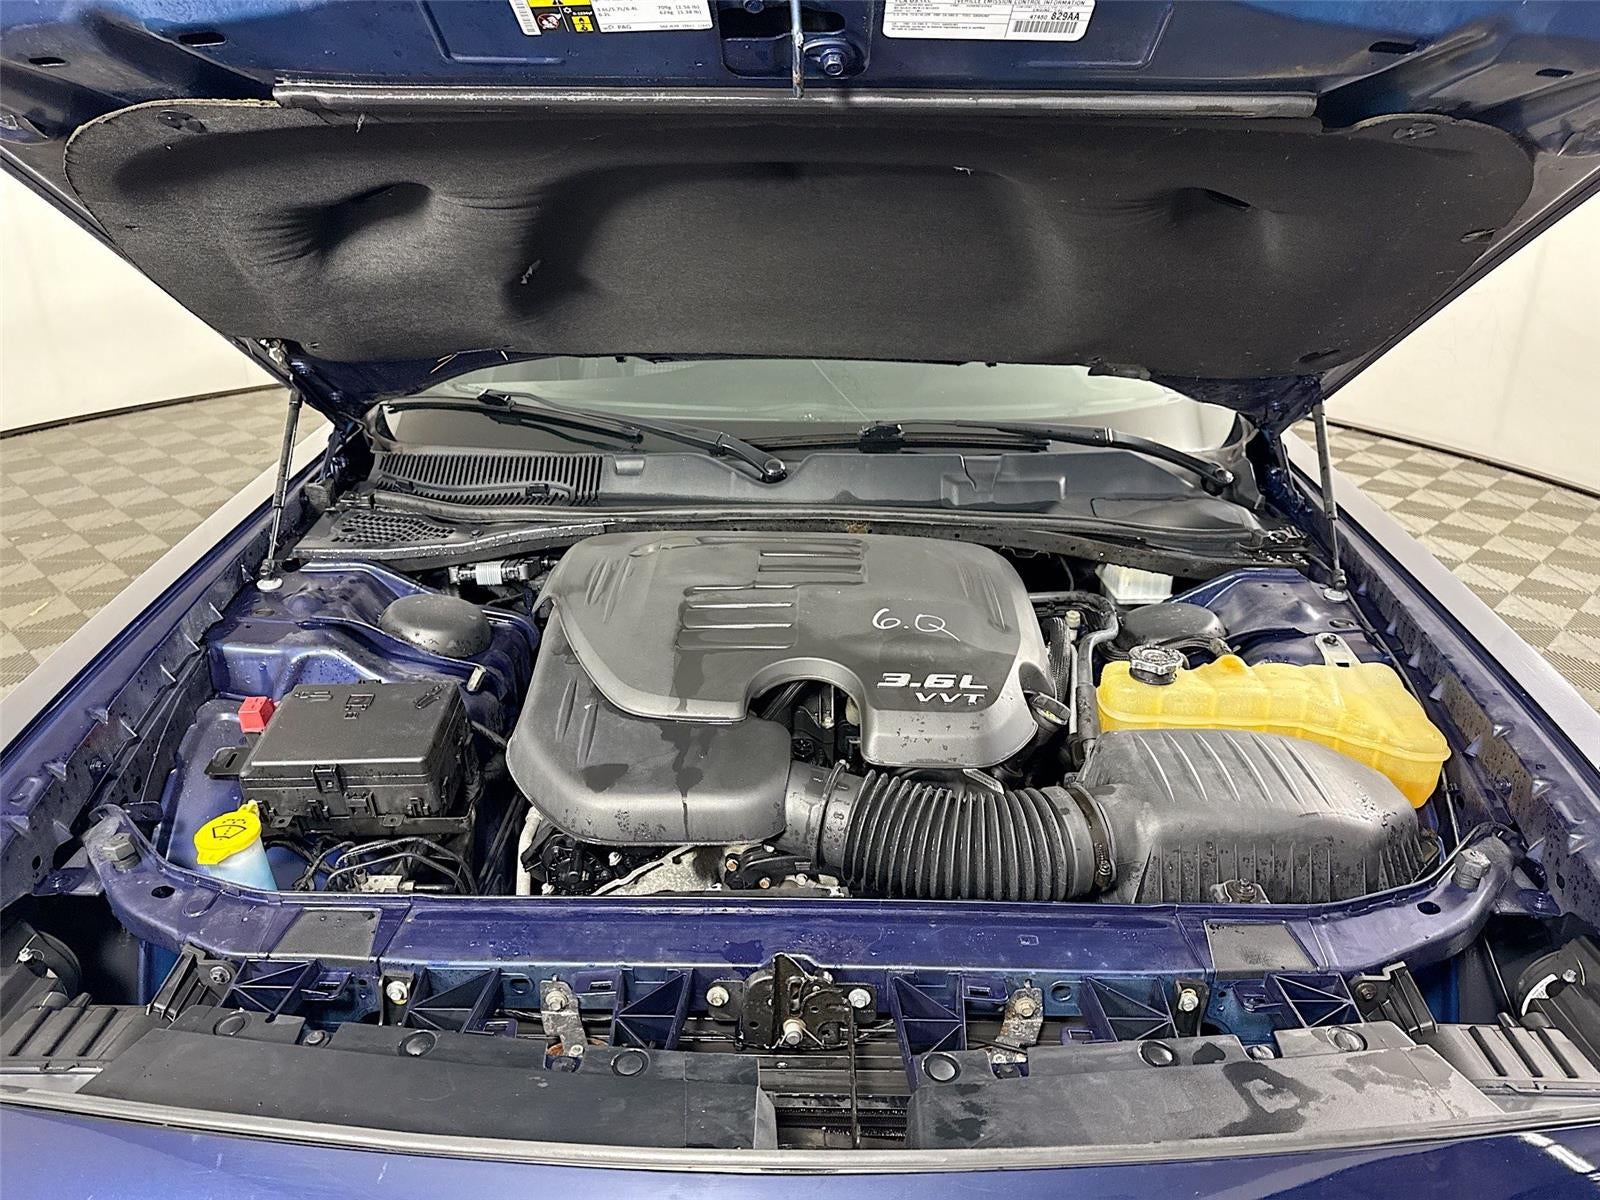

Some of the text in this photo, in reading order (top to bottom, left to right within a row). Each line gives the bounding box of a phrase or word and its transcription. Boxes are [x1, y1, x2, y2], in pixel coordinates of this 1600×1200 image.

[1051, 12, 1080, 21] 829AA
[877, 672, 989, 690] 3.6L
[915, 692, 985, 706] VVT
